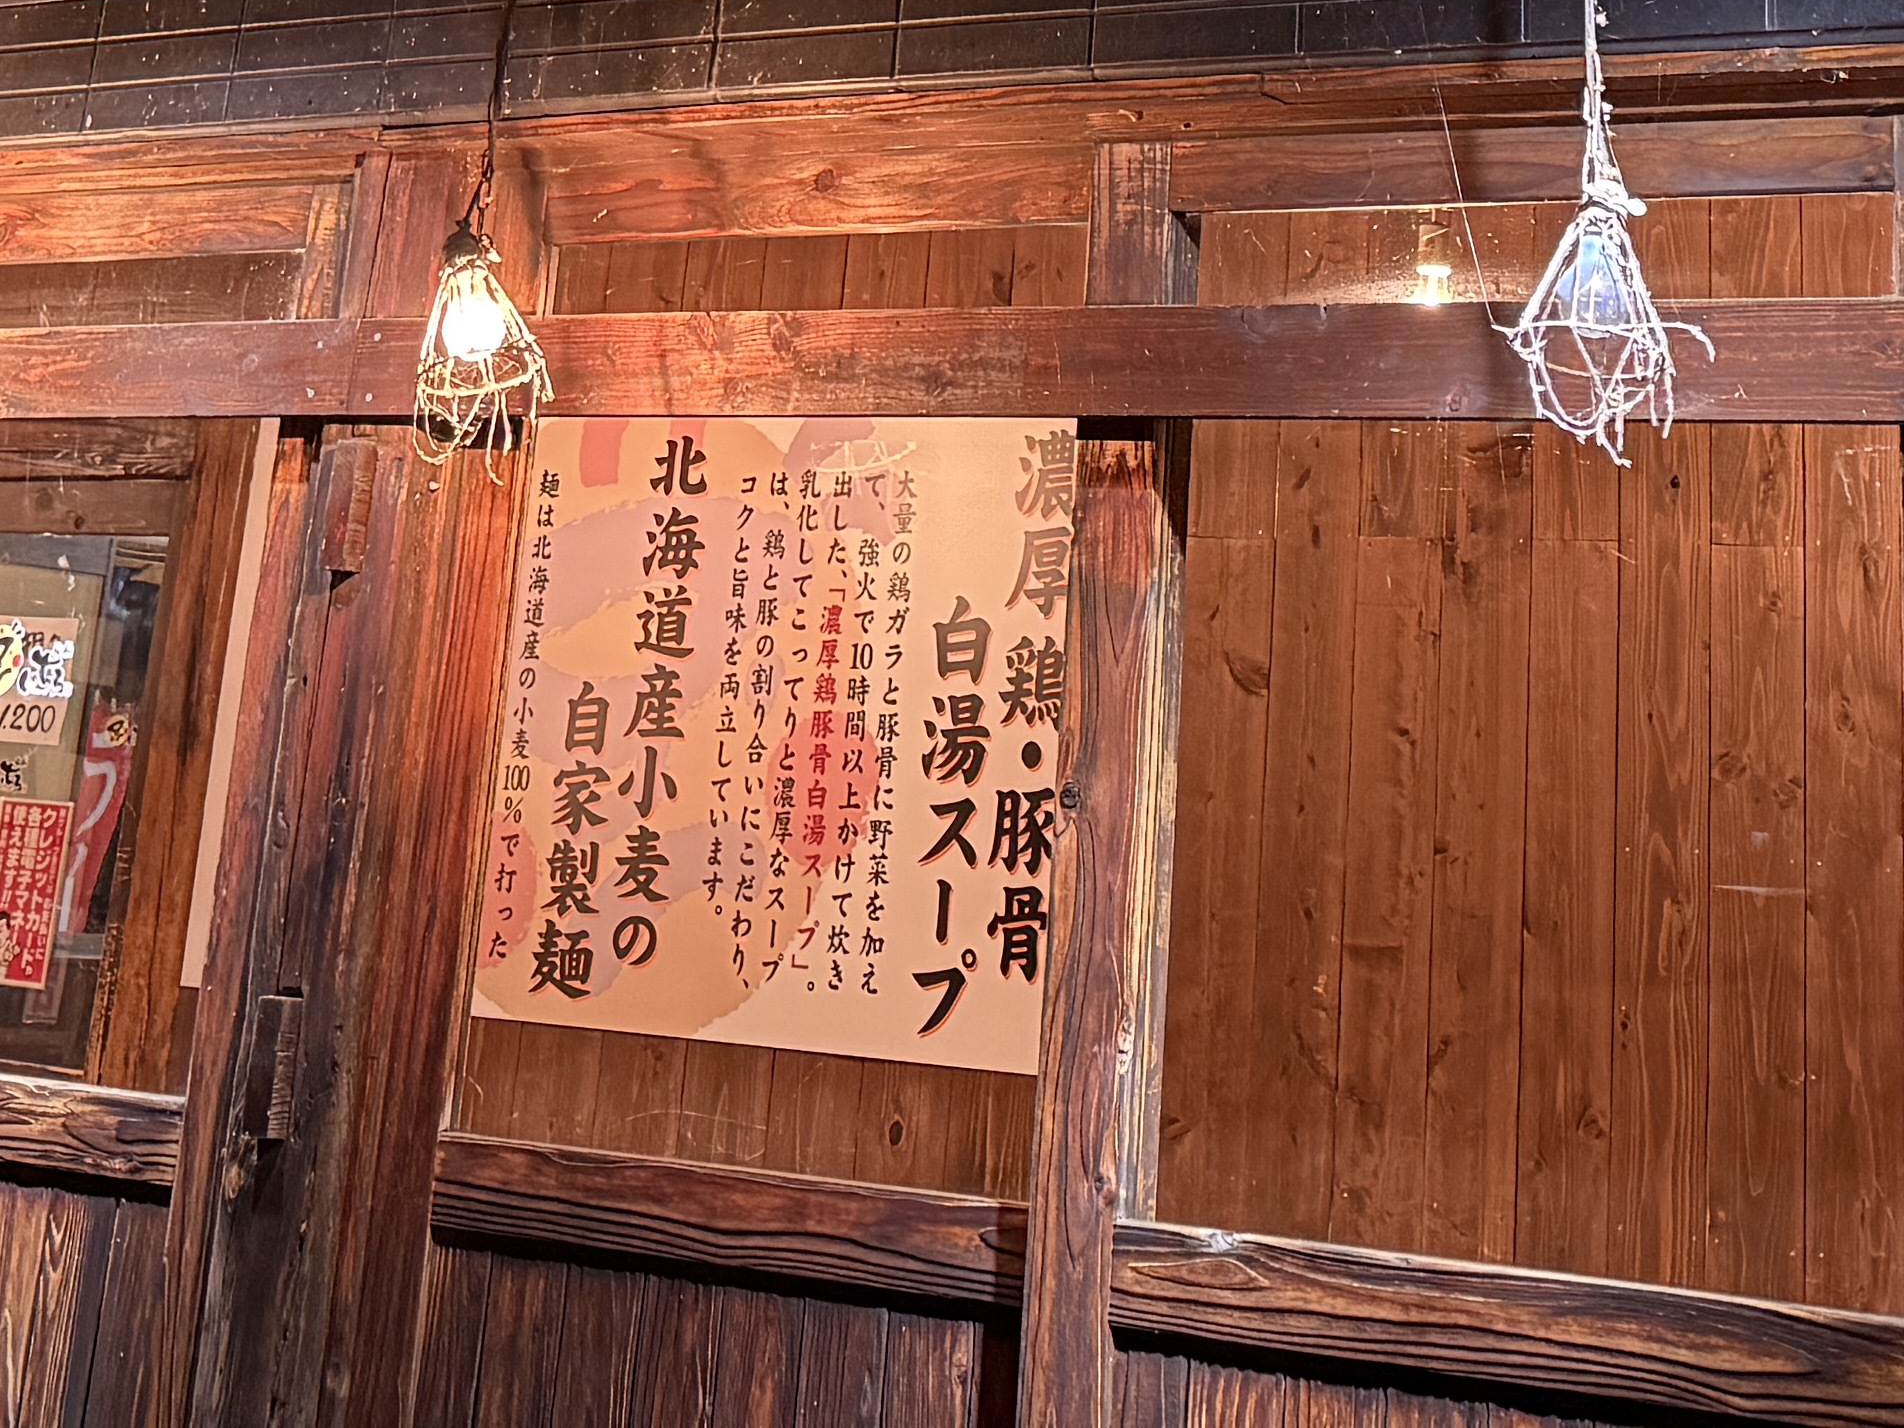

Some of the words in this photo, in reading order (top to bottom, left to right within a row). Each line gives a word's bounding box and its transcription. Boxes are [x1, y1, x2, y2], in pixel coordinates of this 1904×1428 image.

[488, 469, 560, 959] 麺は北海道産の小麦100%で打った
[528, 681, 612, 999] 自家製麺
[612, 435, 708, 966] 北海道産小麦の
[702, 476, 757, 916] コクと旨味を両立しています。
[762, 469, 821, 982] 乳化してこってりと濃厚なスープ
[826, 473, 887, 991] て、強火で10時間以上かけて炊き
[859, 470, 918, 994] 大量の鶏ガラと豚骨に野菜を加え
[912, 595, 993, 1037] 白湯スープ
[987, 428, 1076, 984] 濃厚鶏・豚骨
